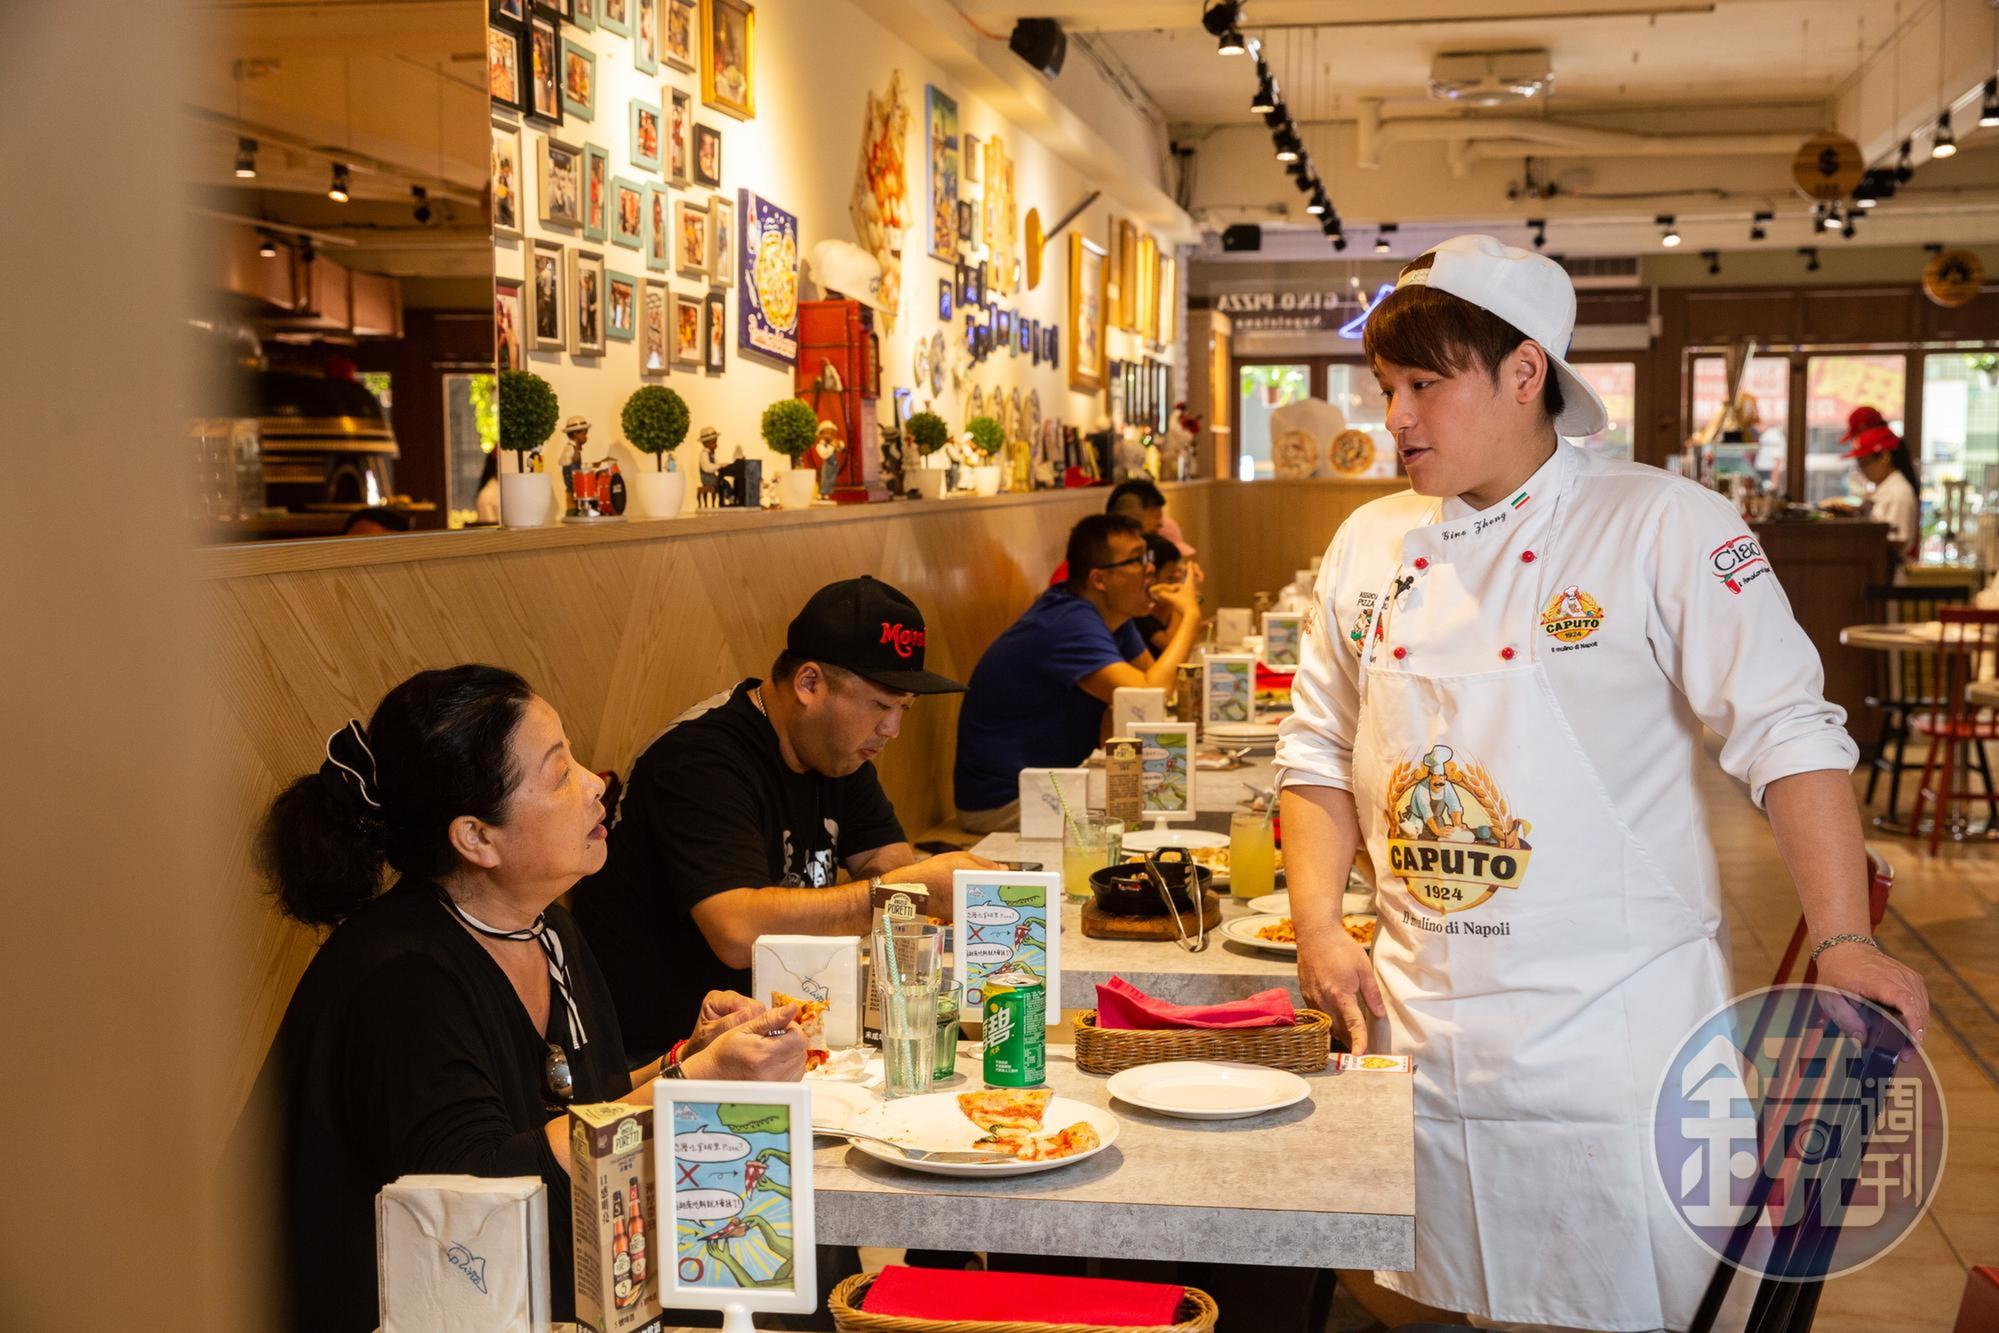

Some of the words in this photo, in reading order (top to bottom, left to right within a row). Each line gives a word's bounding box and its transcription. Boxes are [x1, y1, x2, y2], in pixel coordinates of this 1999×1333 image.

[1714, 542, 1761, 571] Ciao
[1546, 619, 1600, 634] CAPUTO
[1564, 631, 1582, 639] 1924
[1390, 845, 1517, 880] CAPUTO
[1424, 884, 1464, 901] 1924
[1445, 921, 1460, 935] di
[1463, 921, 1511, 938] Napoli
